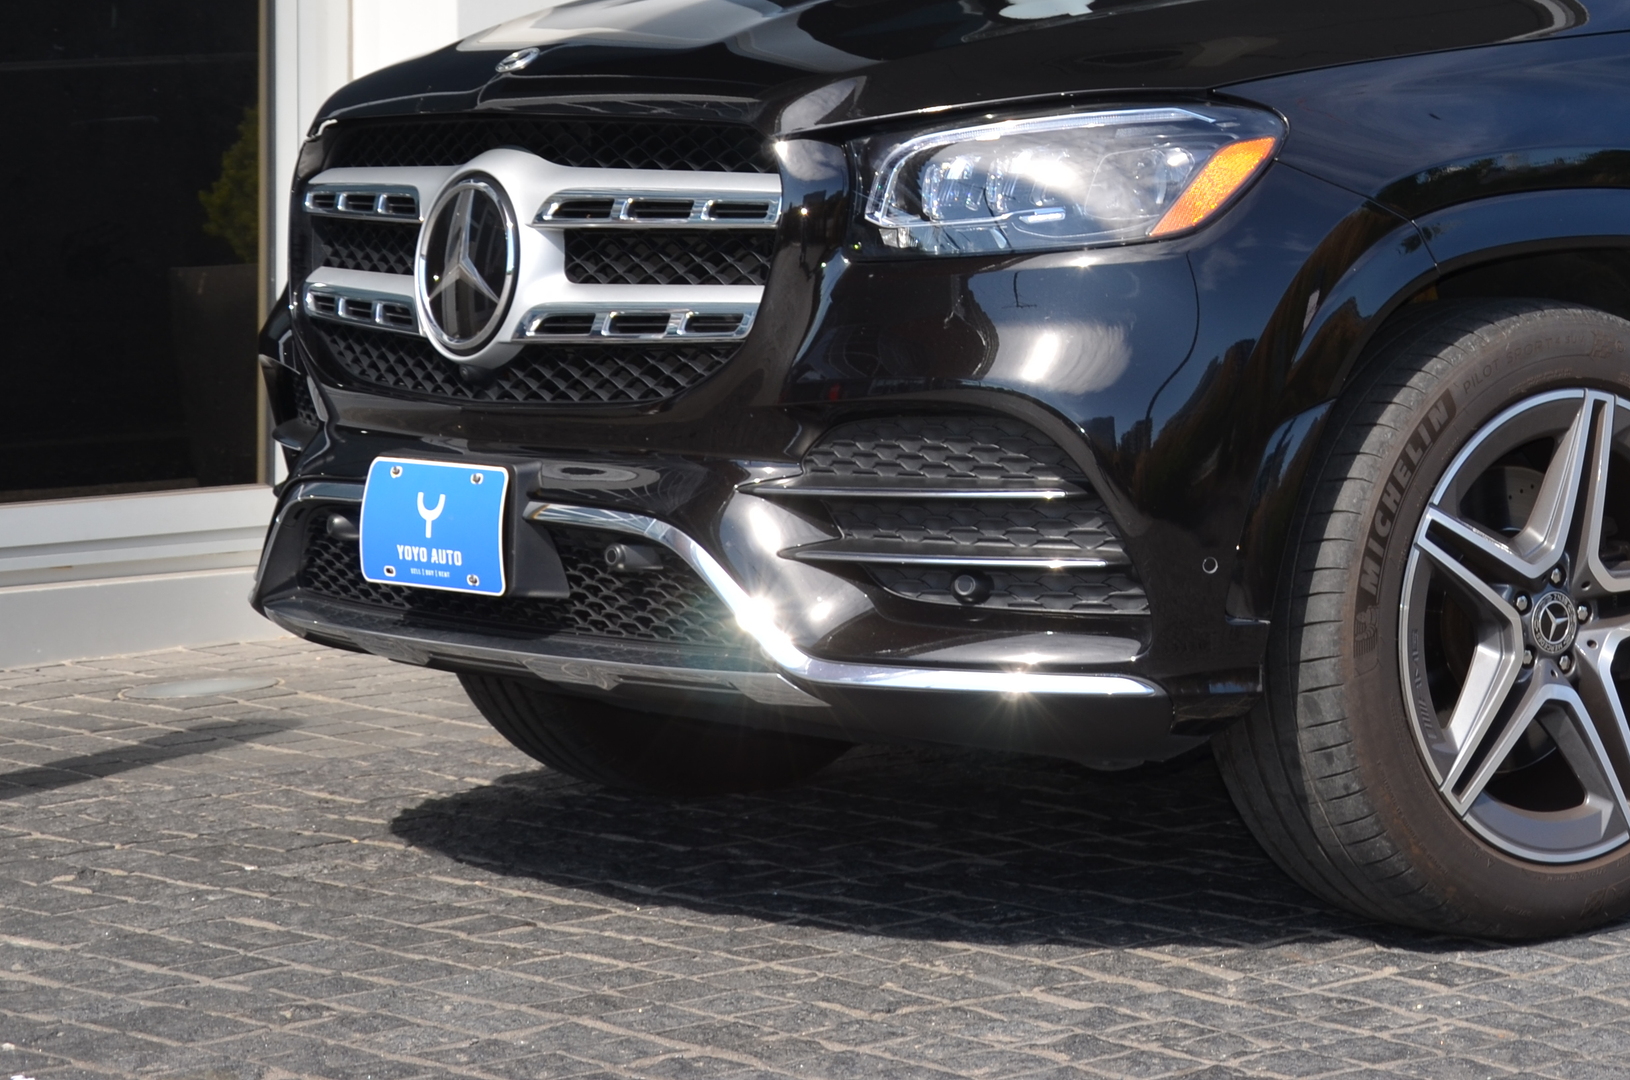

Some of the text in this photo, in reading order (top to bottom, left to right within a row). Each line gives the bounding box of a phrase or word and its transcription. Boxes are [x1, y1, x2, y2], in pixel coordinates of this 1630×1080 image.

[1463, 358, 1500, 395] PILOT
[1506, 337, 1553, 365] SPORT
[1357, 399, 1452, 597] MICHELIN
[396, 544, 463, 566] YOYO AUTO
